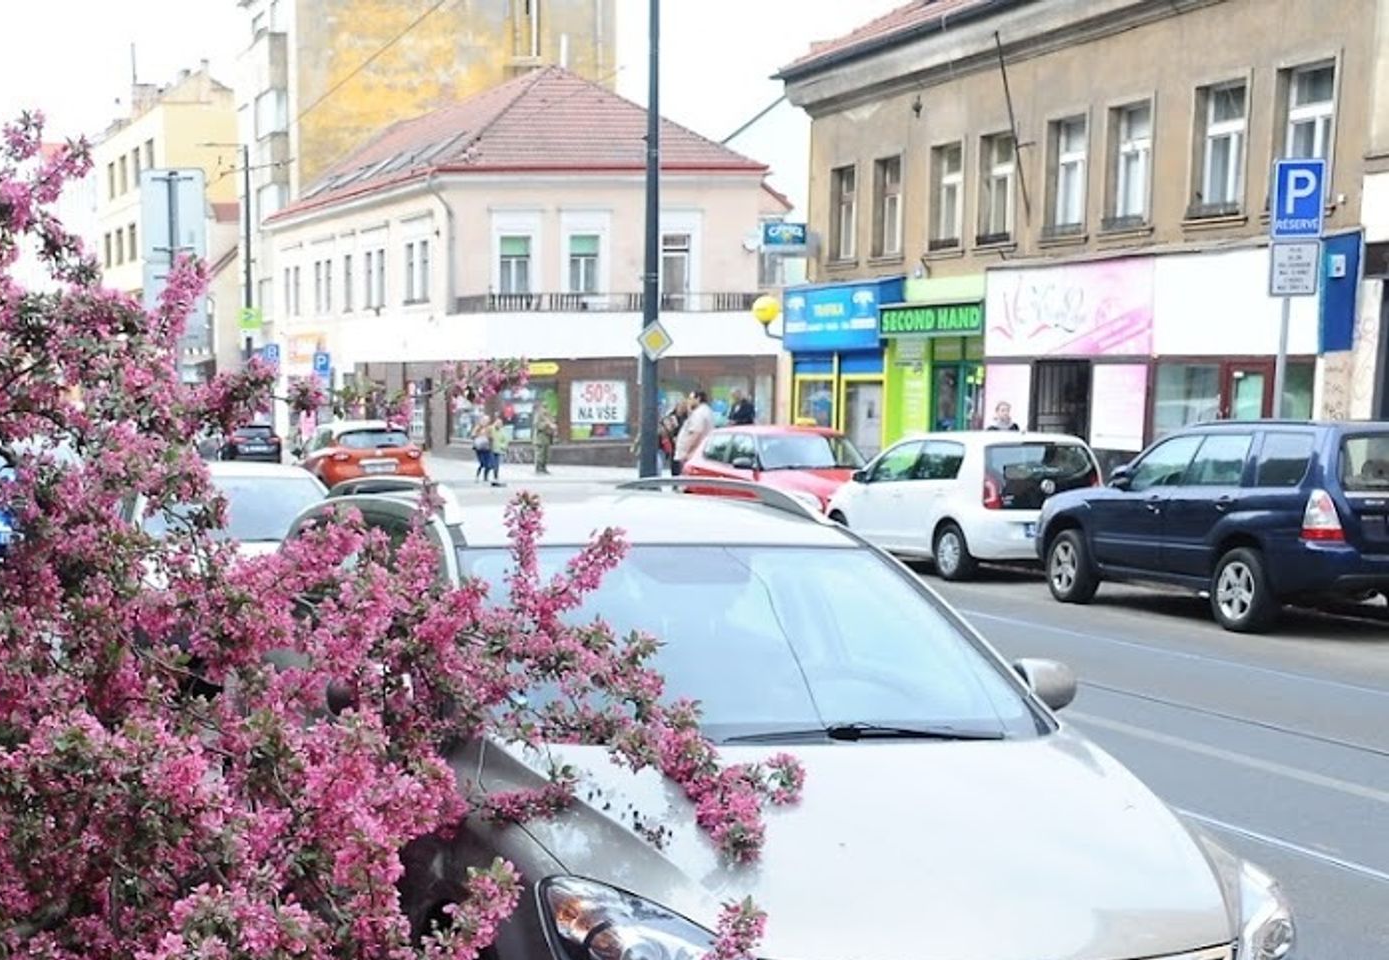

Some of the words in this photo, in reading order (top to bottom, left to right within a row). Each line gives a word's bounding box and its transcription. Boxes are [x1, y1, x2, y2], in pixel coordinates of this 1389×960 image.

[1285, 168, 1316, 214] P
[882, 309, 934, 331] SECOND
[937, 306, 980, 329] HAND
[316, 356, 327, 370] P
[580, 383, 617, 404] -50%
[578, 407, 594, 420] NA
[596, 404, 617, 420] VŠE
